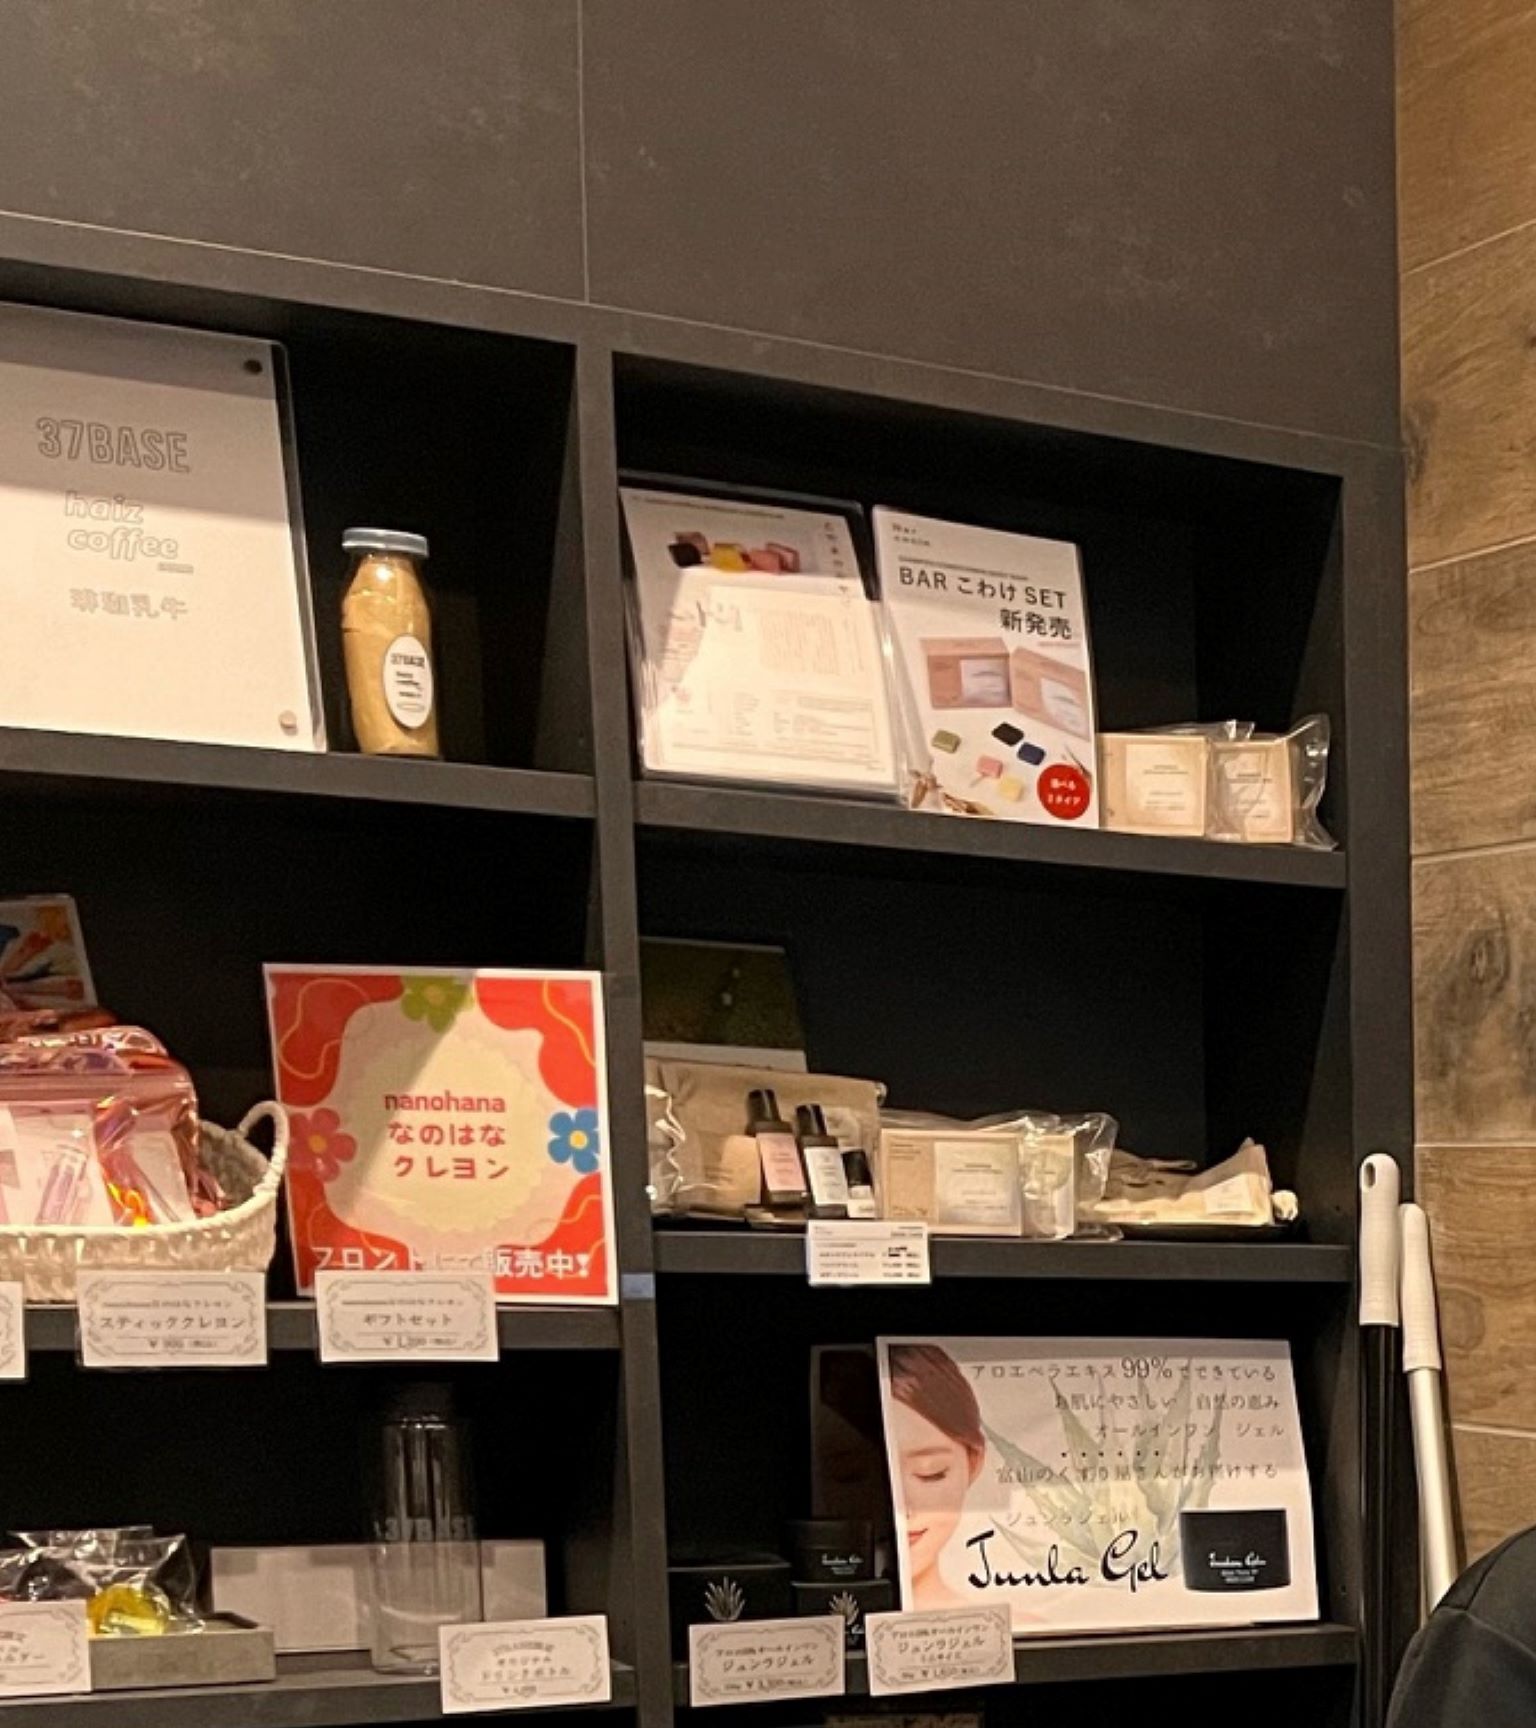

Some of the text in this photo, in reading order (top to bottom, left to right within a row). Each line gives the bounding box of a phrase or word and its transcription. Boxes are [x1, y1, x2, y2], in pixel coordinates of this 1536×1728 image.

[36, 416, 190, 474] 37BASE
[64, 490, 144, 524] haiz
[67, 526, 179, 562] coffee
[899, 567, 948, 591] BAR
[956, 576, 1017, 603] こわけ
[1025, 586, 1067, 610] SET
[1000, 608, 1072, 640] 新発売
[384, 1090, 507, 1114] nanohana
[389, 1122, 507, 1147] なのはな
[394, 1155, 510, 1180] クレヨン
[966, 1530, 1168, 1593] Junla Gel
